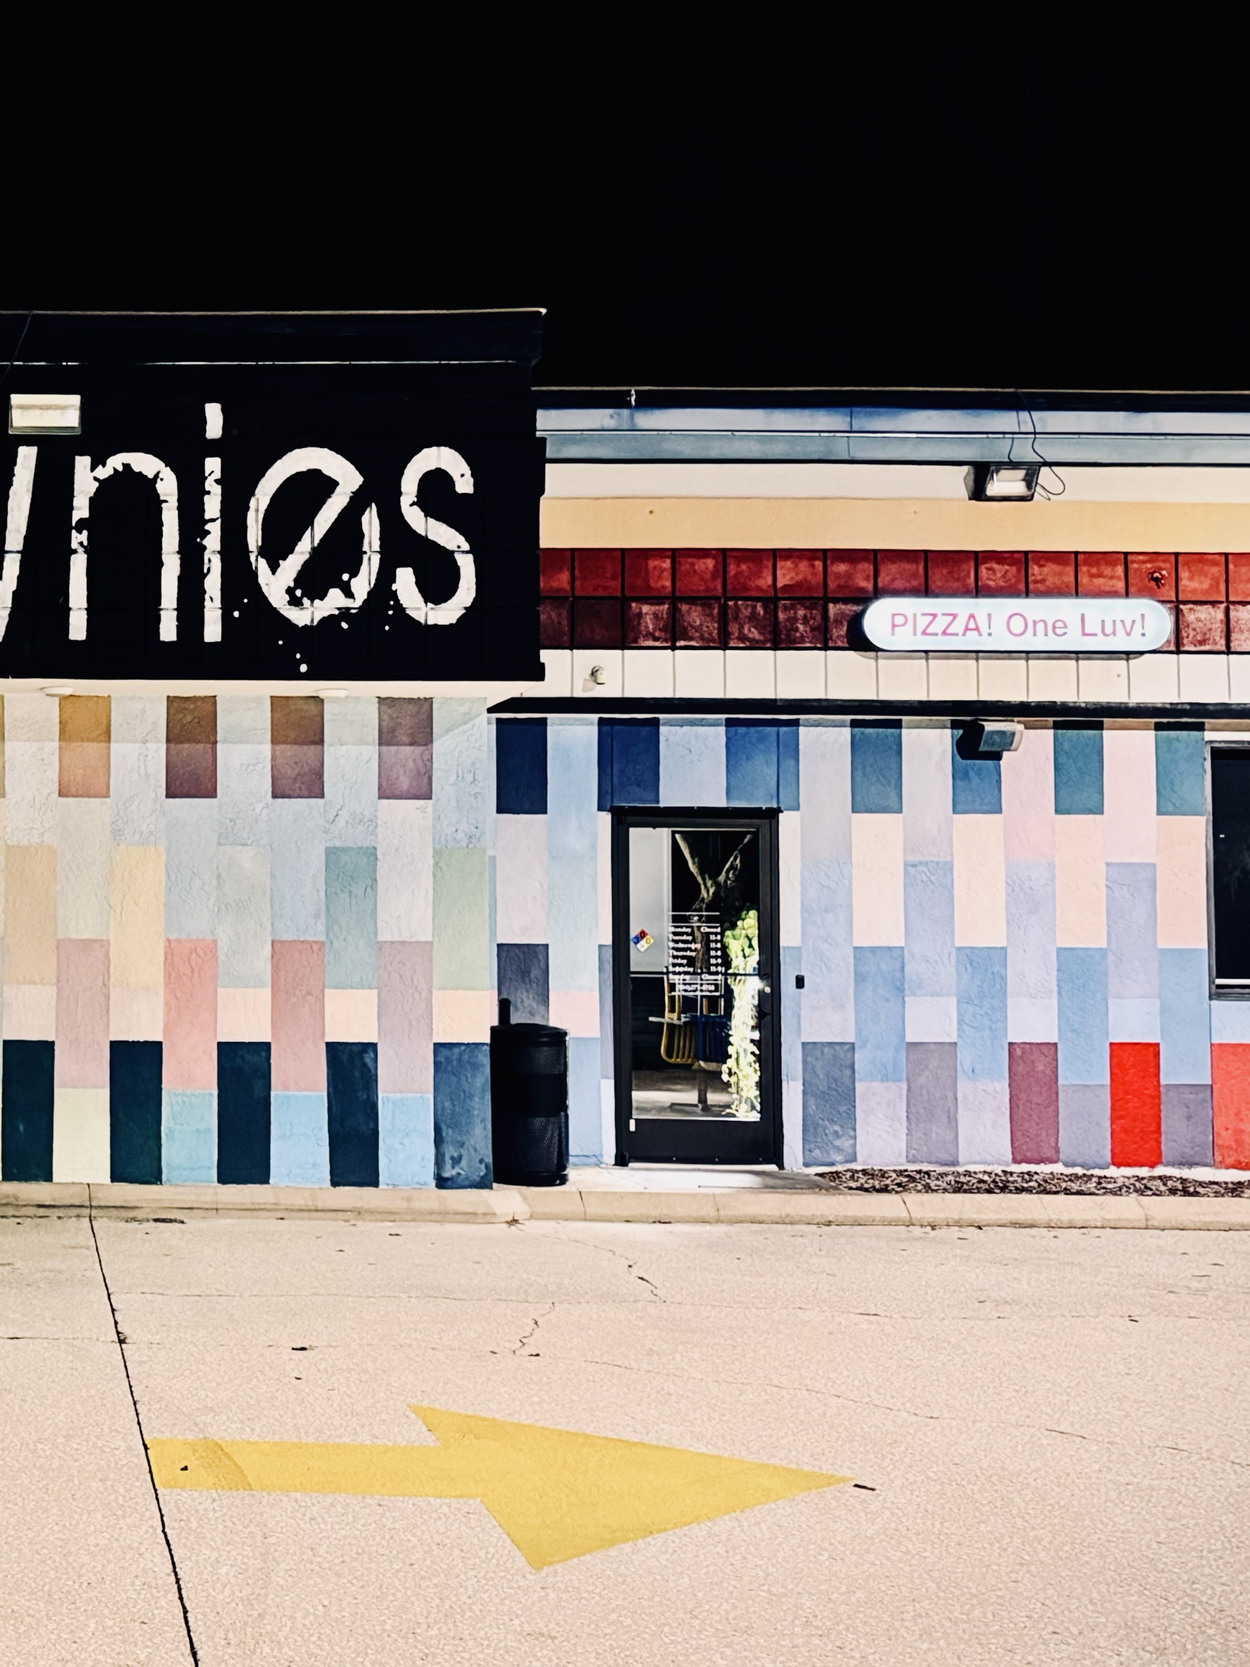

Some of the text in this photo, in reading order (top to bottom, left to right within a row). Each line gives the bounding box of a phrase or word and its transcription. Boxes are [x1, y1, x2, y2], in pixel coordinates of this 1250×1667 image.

[889, 612, 1147, 637] PIZZA! One Luv!
